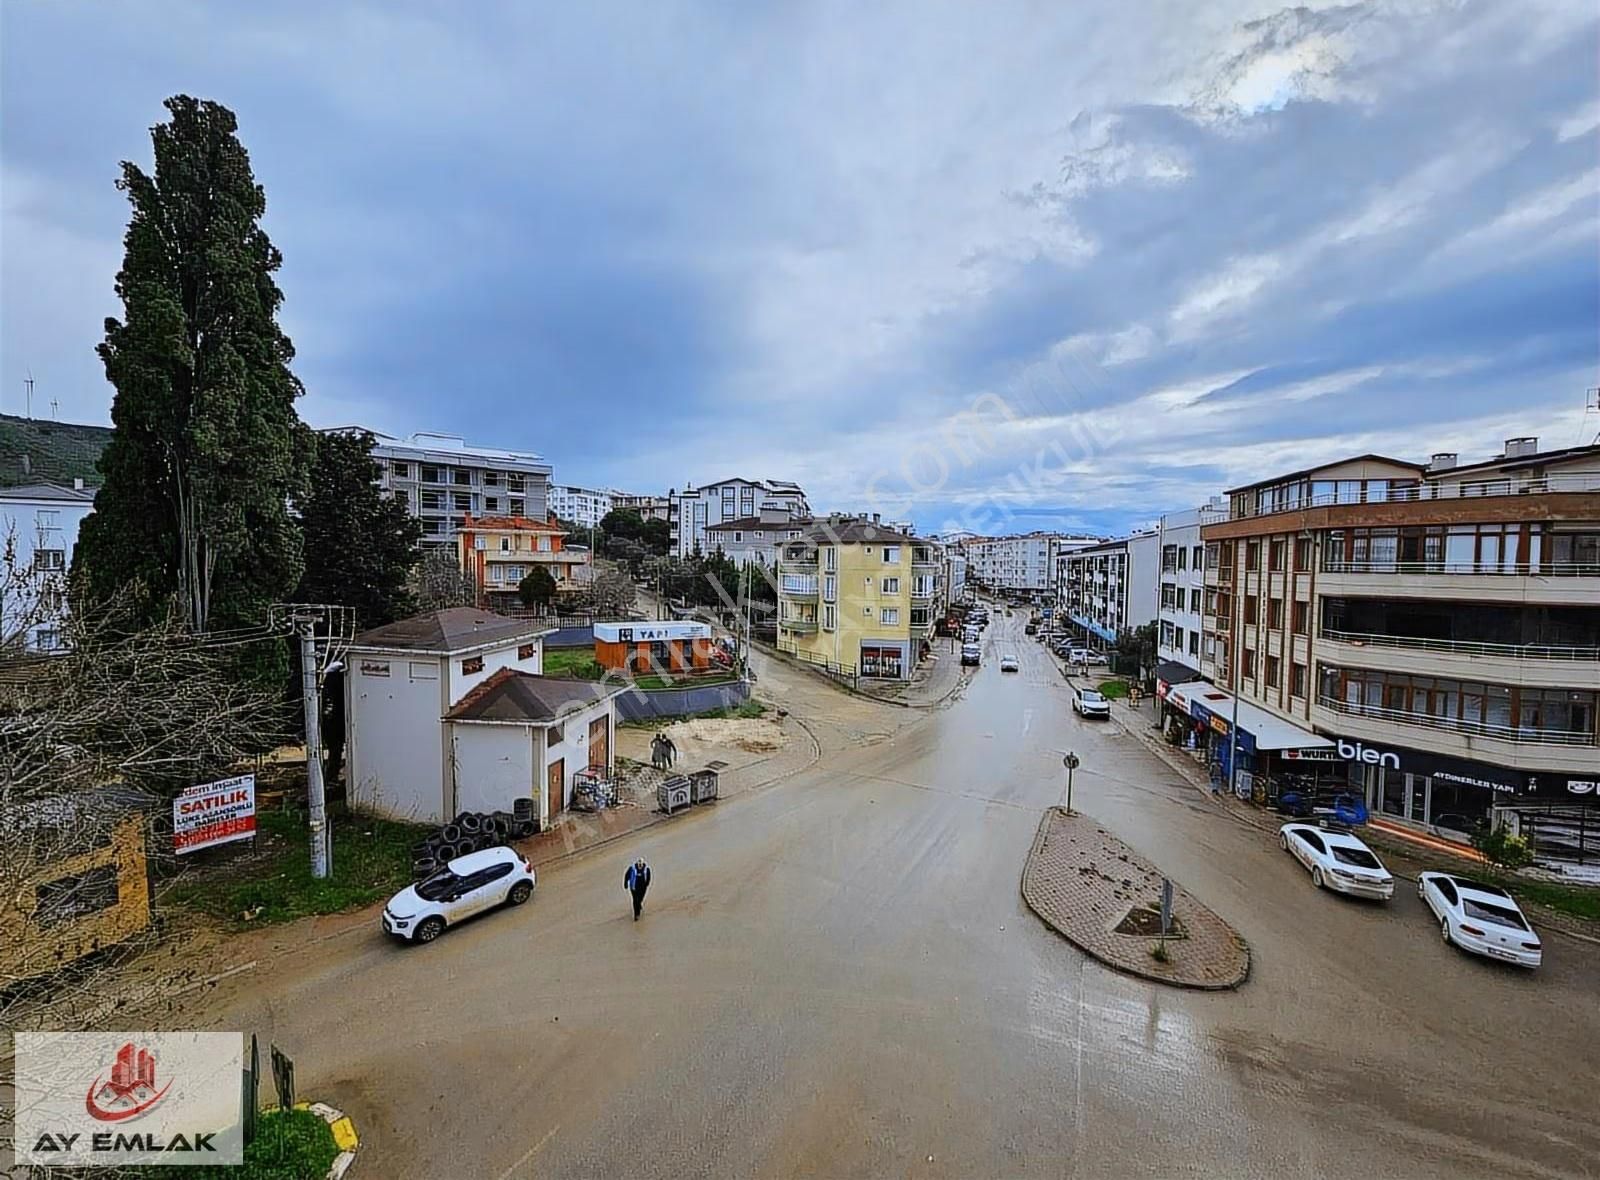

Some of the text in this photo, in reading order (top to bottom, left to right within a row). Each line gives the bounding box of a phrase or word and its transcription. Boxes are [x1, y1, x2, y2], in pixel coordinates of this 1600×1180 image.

[1338, 739, 1400, 769] bien
[1491, 782, 1514, 793] YAPI
[180, 790, 248, 815] SATILIK
